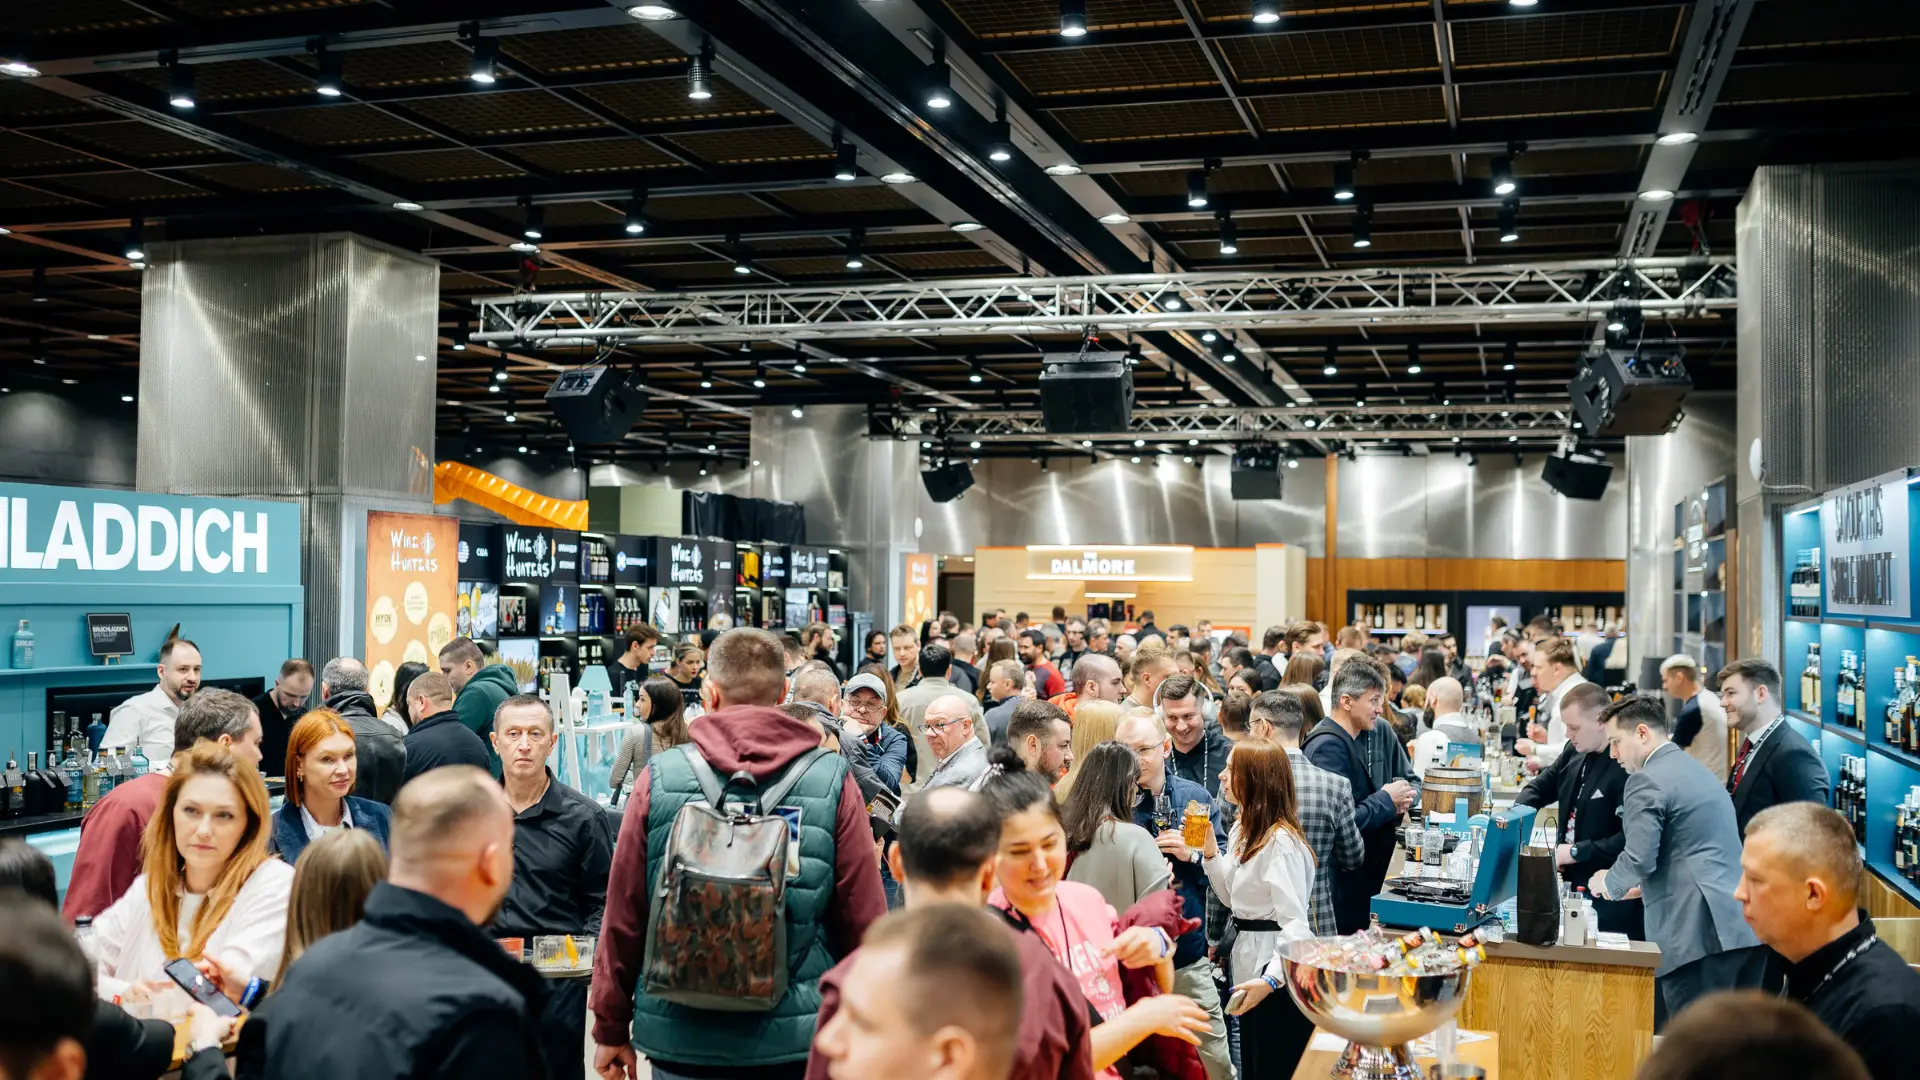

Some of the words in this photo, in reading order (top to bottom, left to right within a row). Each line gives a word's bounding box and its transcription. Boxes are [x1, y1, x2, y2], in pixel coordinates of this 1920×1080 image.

[0, 497, 268, 574] LADDICH
[1051, 559, 1135, 574] DALMORE
[375, 614, 392, 623] HYDE
